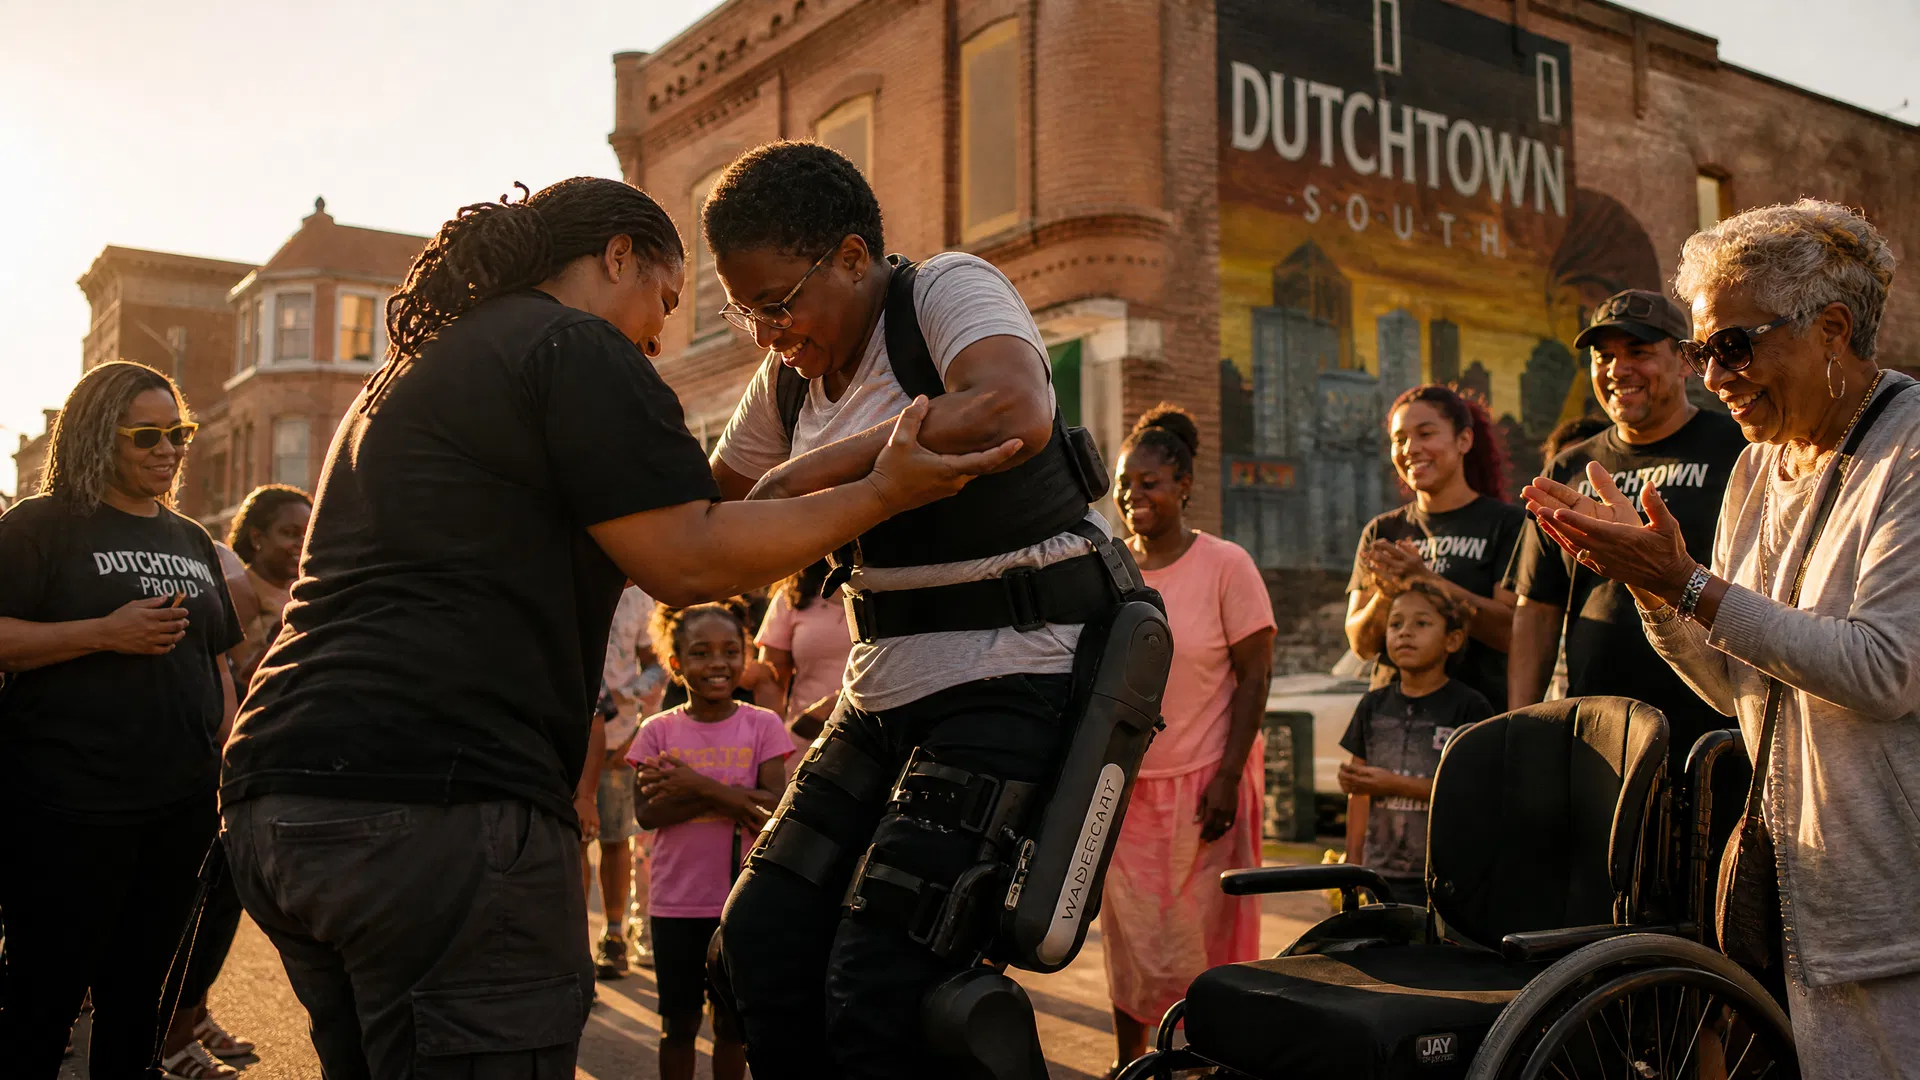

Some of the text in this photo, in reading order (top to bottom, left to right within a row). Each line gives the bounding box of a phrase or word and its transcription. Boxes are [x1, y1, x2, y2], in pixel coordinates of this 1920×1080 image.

[1230, 61, 1567, 218] DUTCHTOWN
[1578, 462, 1710, 499] DCHTOWN
[93, 550, 215, 586] DUTCHTOWN
[1422, 1037, 1452, 1056] JAY
